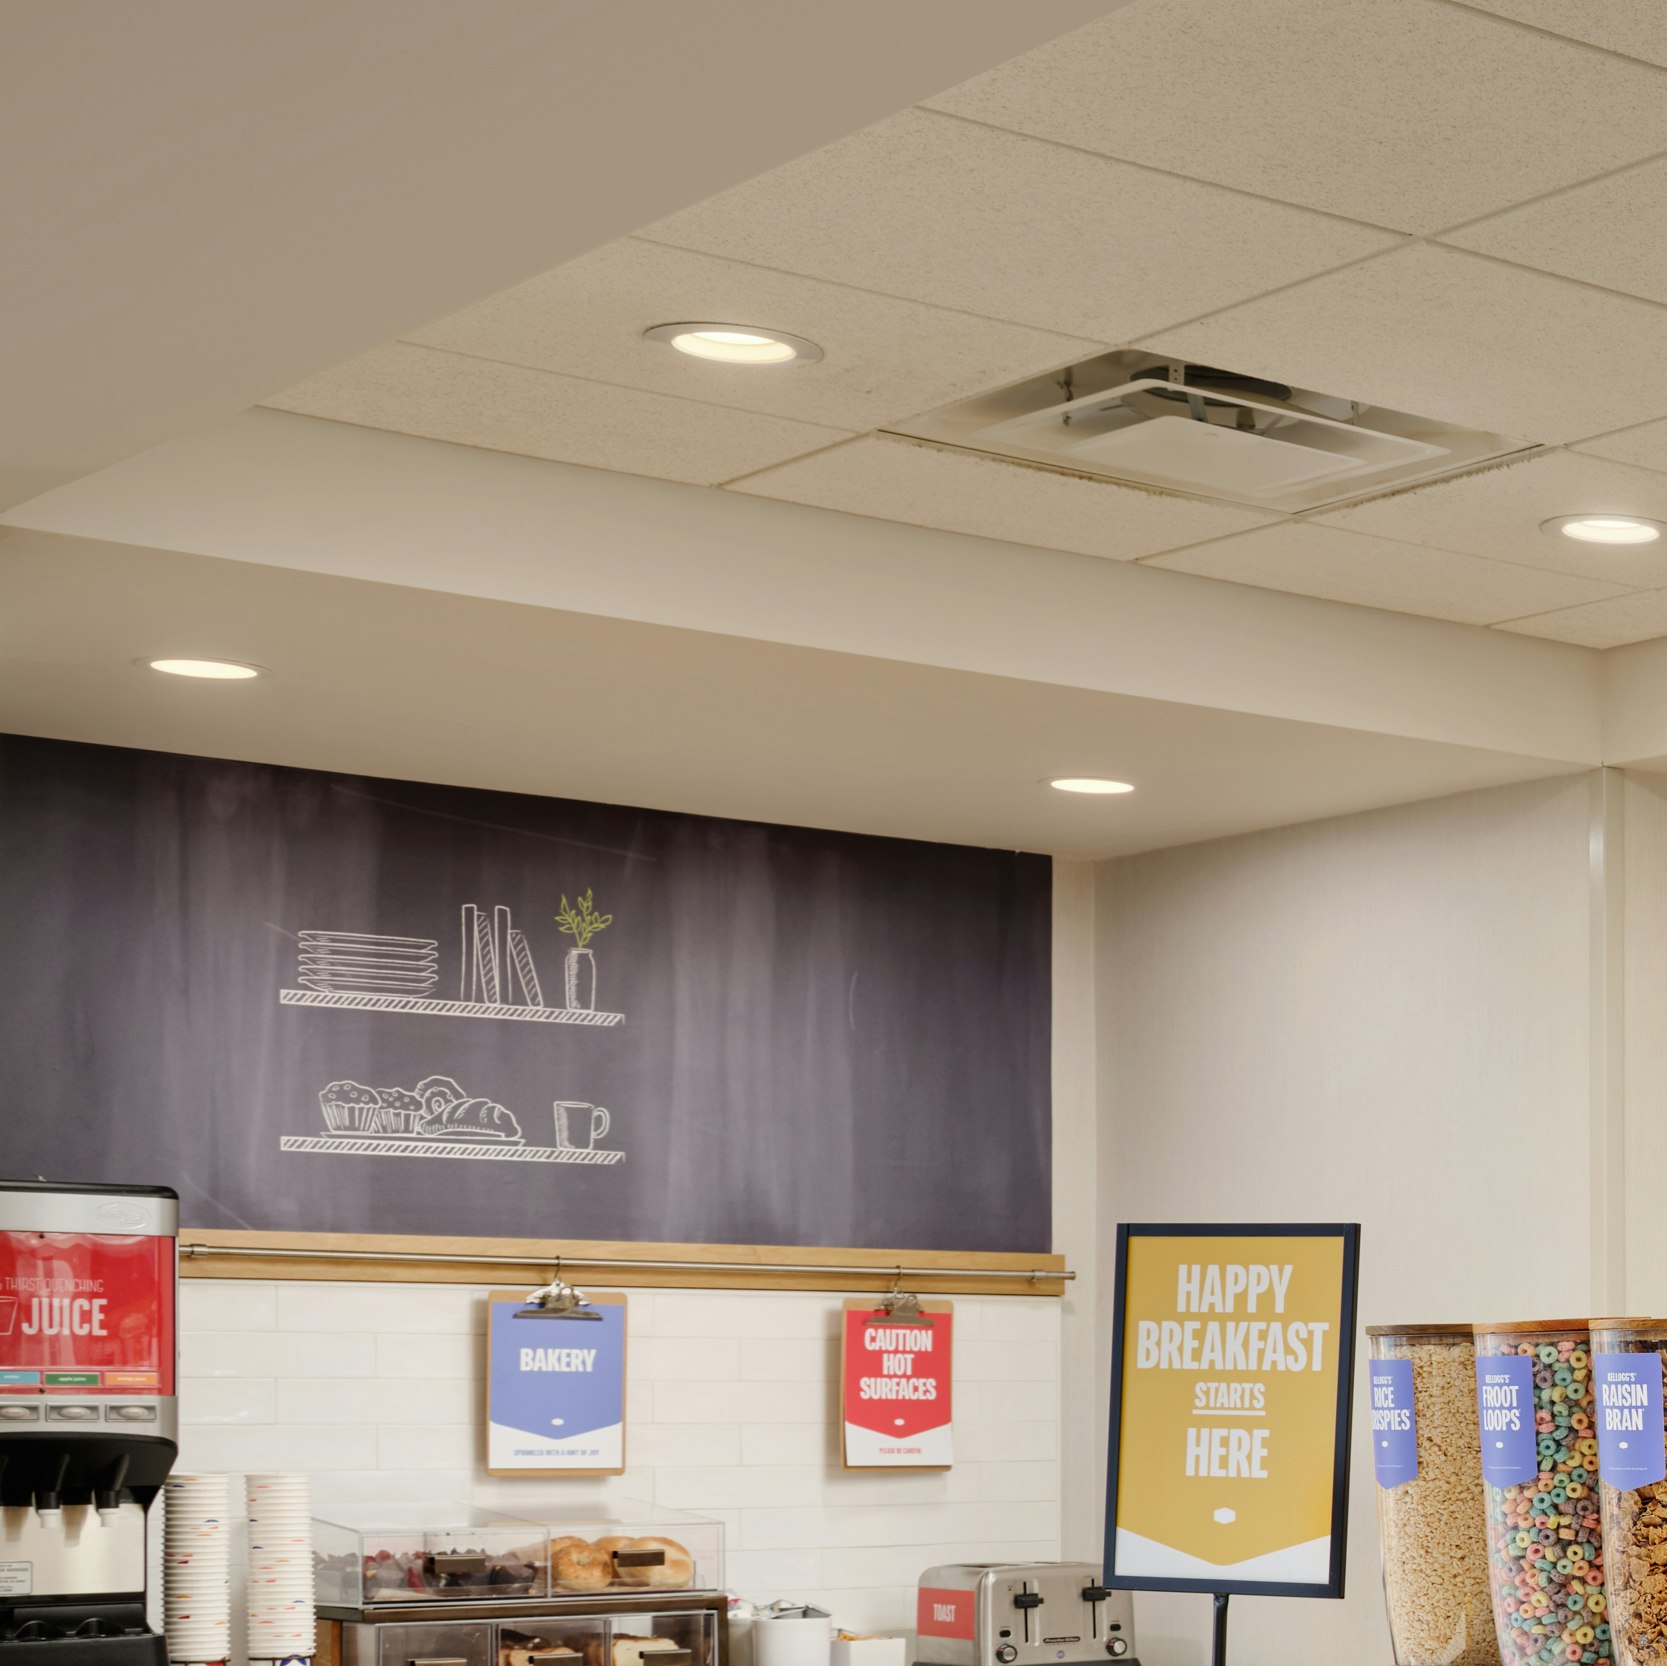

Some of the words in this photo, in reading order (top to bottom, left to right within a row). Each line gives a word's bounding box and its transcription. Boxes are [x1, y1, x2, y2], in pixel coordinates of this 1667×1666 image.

[5, 1277, 41, 1292] THIRST
[44, 1278, 104, 1293] QUENCHING
[1177, 1264, 1293, 1313] HAPPY
[21, 1297, 108, 1336] JUICE
[864, 1328, 933, 1351] CAUTION
[1136, 1320, 1330, 1372] BREAKFAST
[520, 1348, 597, 1372] BAKERY
[882, 1353, 915, 1375] HOT
[860, 1376, 937, 1400] SURFACES
[1194, 1382, 1266, 1409] STARTS
[1374, 1387, 1395, 1407] RICE
[1483, 1385, 1519, 1407] FROOT
[1602, 1384, 1648, 1406] RAISIN
[1483, 1409, 1521, 1431] LOOPS
[1605, 1408, 1644, 1430] BRAN
[1185, 1427, 1270, 1479] HERE
[933, 1603, 957, 1622] TOAST
